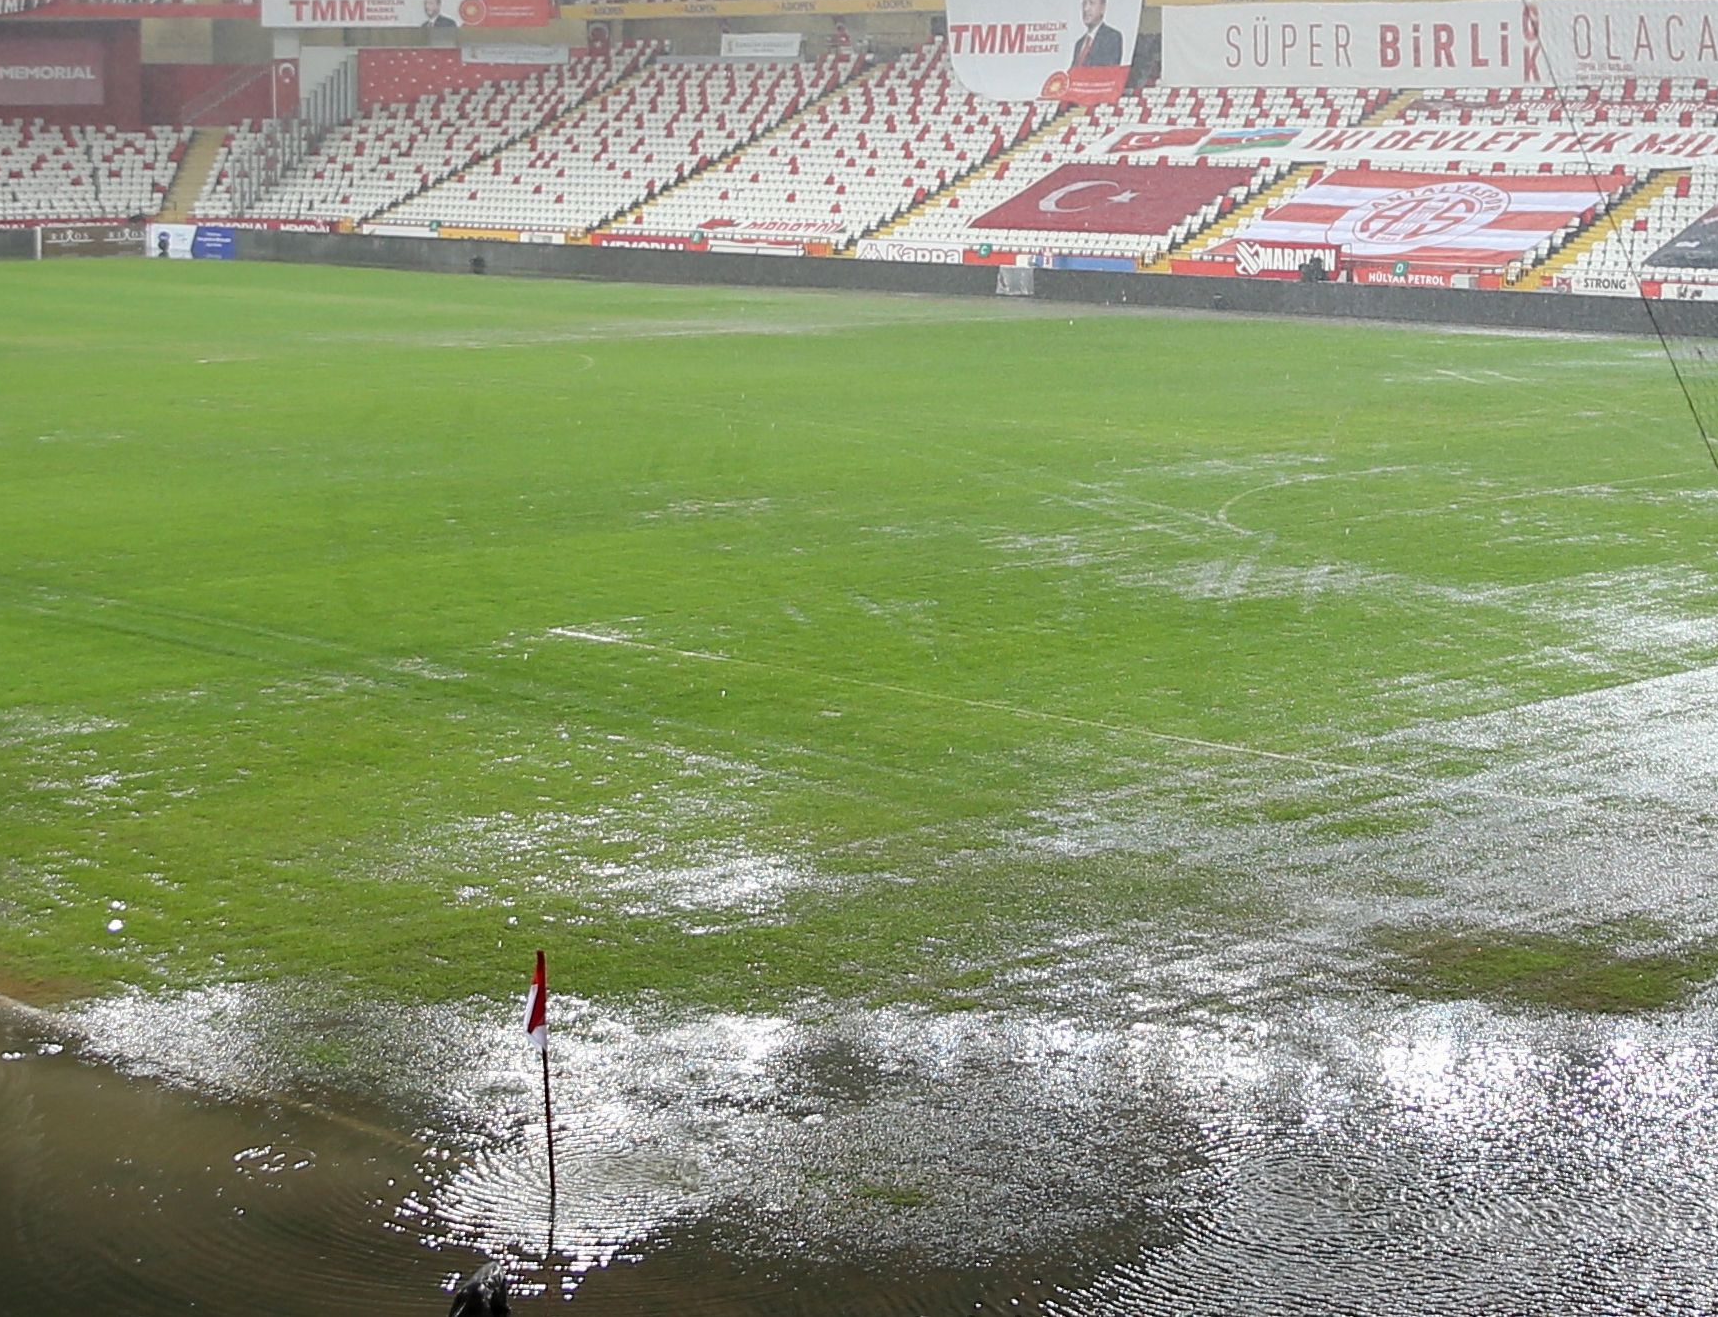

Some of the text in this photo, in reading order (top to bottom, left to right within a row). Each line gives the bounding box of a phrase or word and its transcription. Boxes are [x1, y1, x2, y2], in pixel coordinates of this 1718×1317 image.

[289, 0, 366, 22] TMM
[950, 23, 1026, 54] TMM
[1027, 33, 1057, 42] MASKE
[1226, 16, 1353, 69] SÜPER
[1025, 44, 1060, 53] MESAFE
[1372, 130, 1541, 153] DEVLET
[1541, 130, 1629, 154] TEK
[886, 244, 962, 264] Kappa
[1259, 246, 1336, 272] MARATON
[1408, 274, 1444, 286] PETROL
[1583, 277, 1627, 290] STRONG
